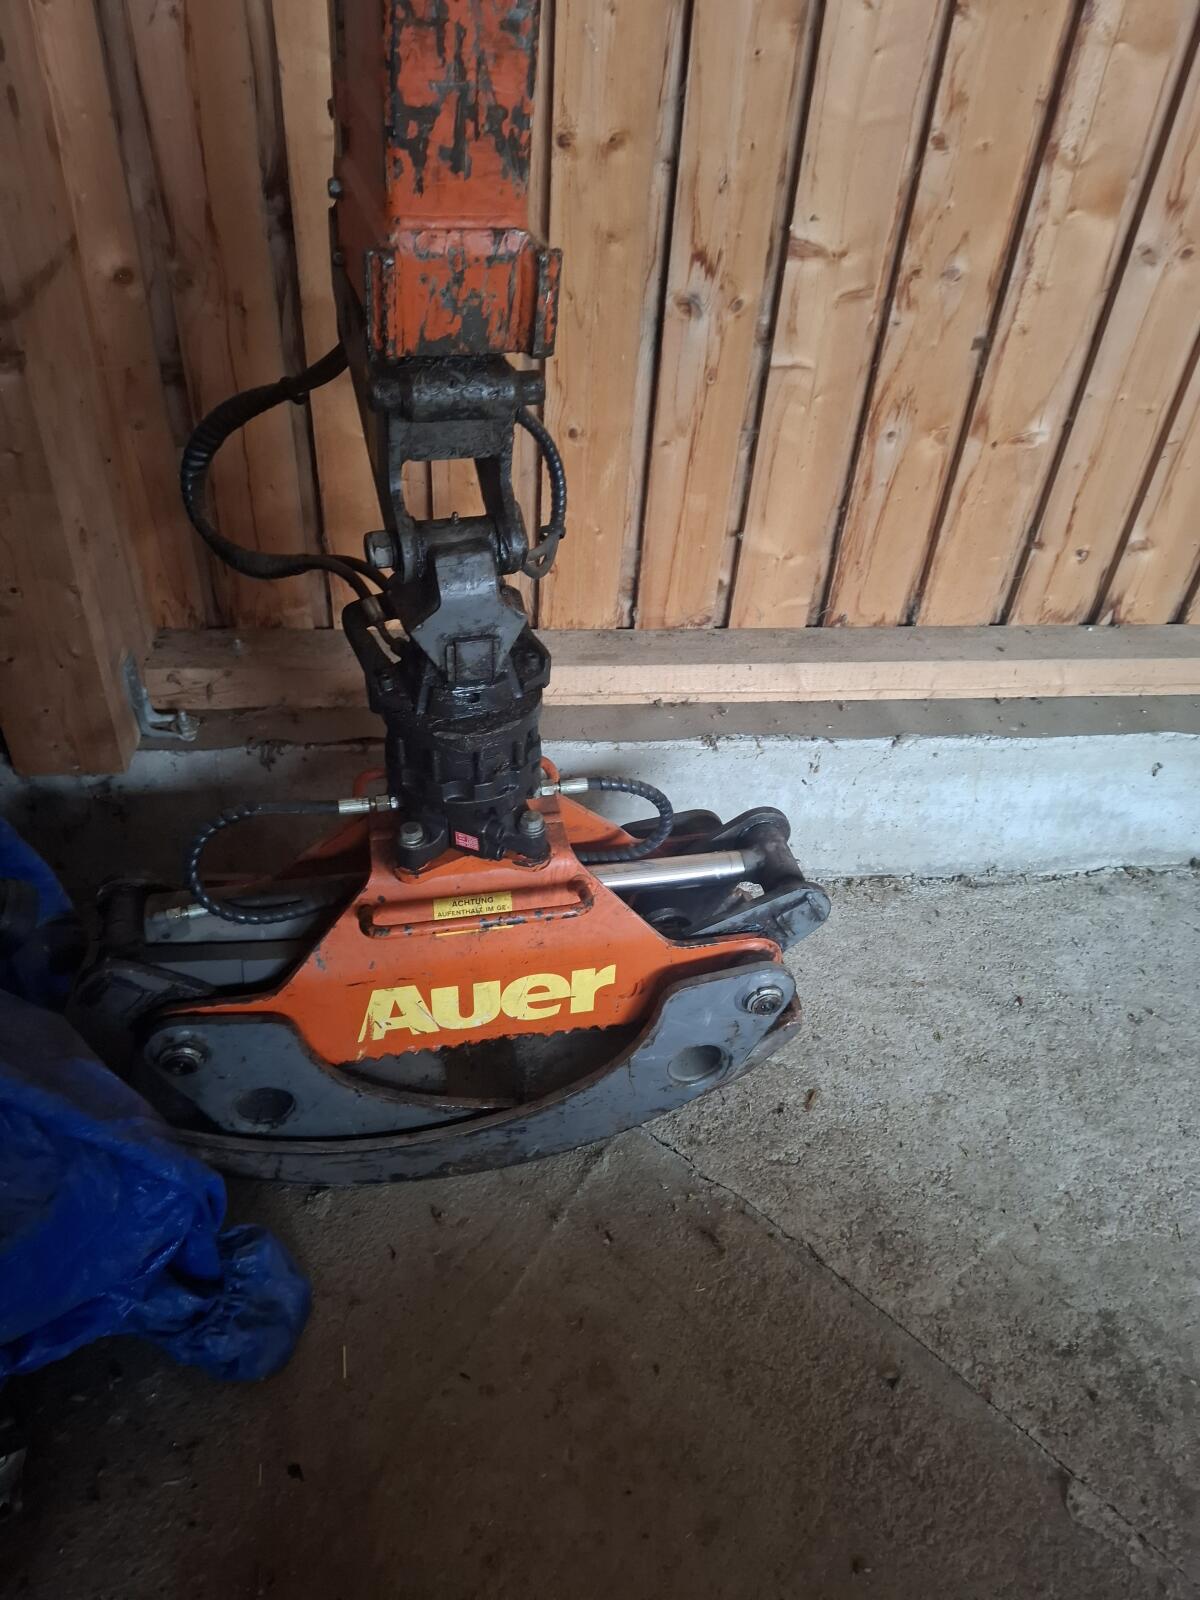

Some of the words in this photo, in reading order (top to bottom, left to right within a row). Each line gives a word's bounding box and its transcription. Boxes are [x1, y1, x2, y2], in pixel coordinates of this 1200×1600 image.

[452, 896, 494, 907] ACHTUNG
[437, 906, 483, 918] AUFENTHALT
[357, 964, 617, 1043] Auer
